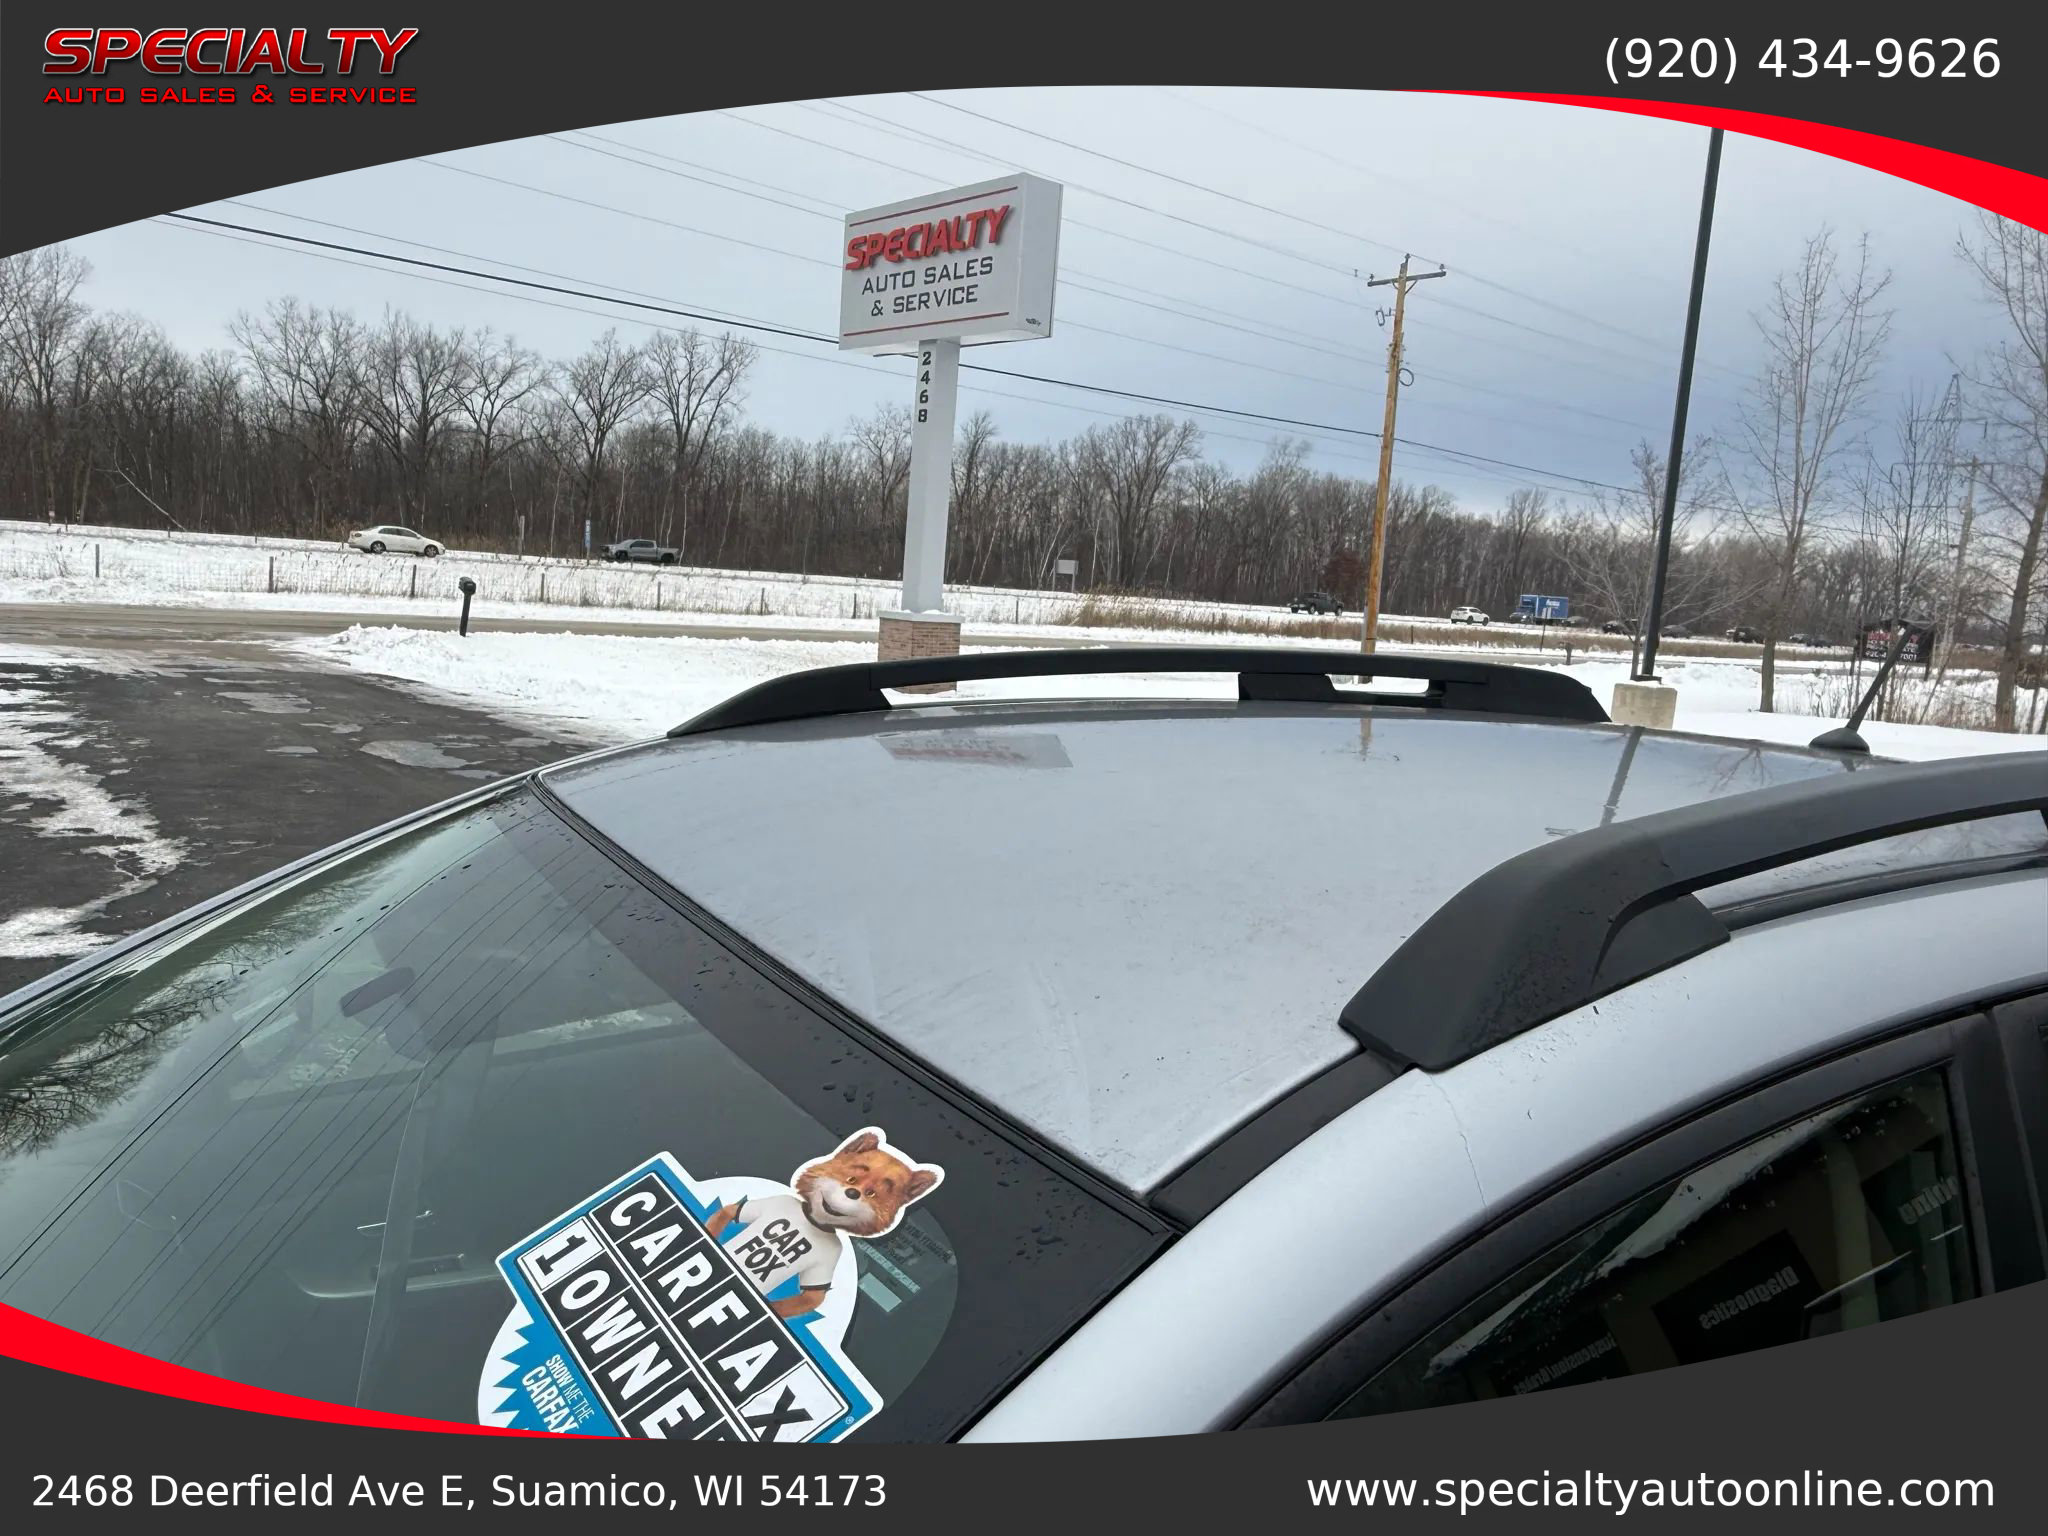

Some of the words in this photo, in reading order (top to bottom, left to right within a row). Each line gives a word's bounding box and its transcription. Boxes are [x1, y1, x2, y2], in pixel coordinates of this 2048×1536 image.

[845, 205, 1010, 271] SPECIALTY
[862, 270, 915, 295] AUTO
[924, 256, 993, 285] SALES
[871, 300, 883, 316] &
[893, 284, 978, 314] SERVICE
[918, 351, 931, 423] 2468
[734, 1240, 786, 1283] FOX
[762, 1217, 813, 1264] CAR
[609, 1190, 813, 1442] CARFAX
[546, 1354, 575, 1388] SHOW
[560, 1269, 715, 1441] OWNE
[522, 1365, 580, 1434] CARFAX
[563, 1382, 584, 1405] ME
[572, 1397, 595, 1424] THE
